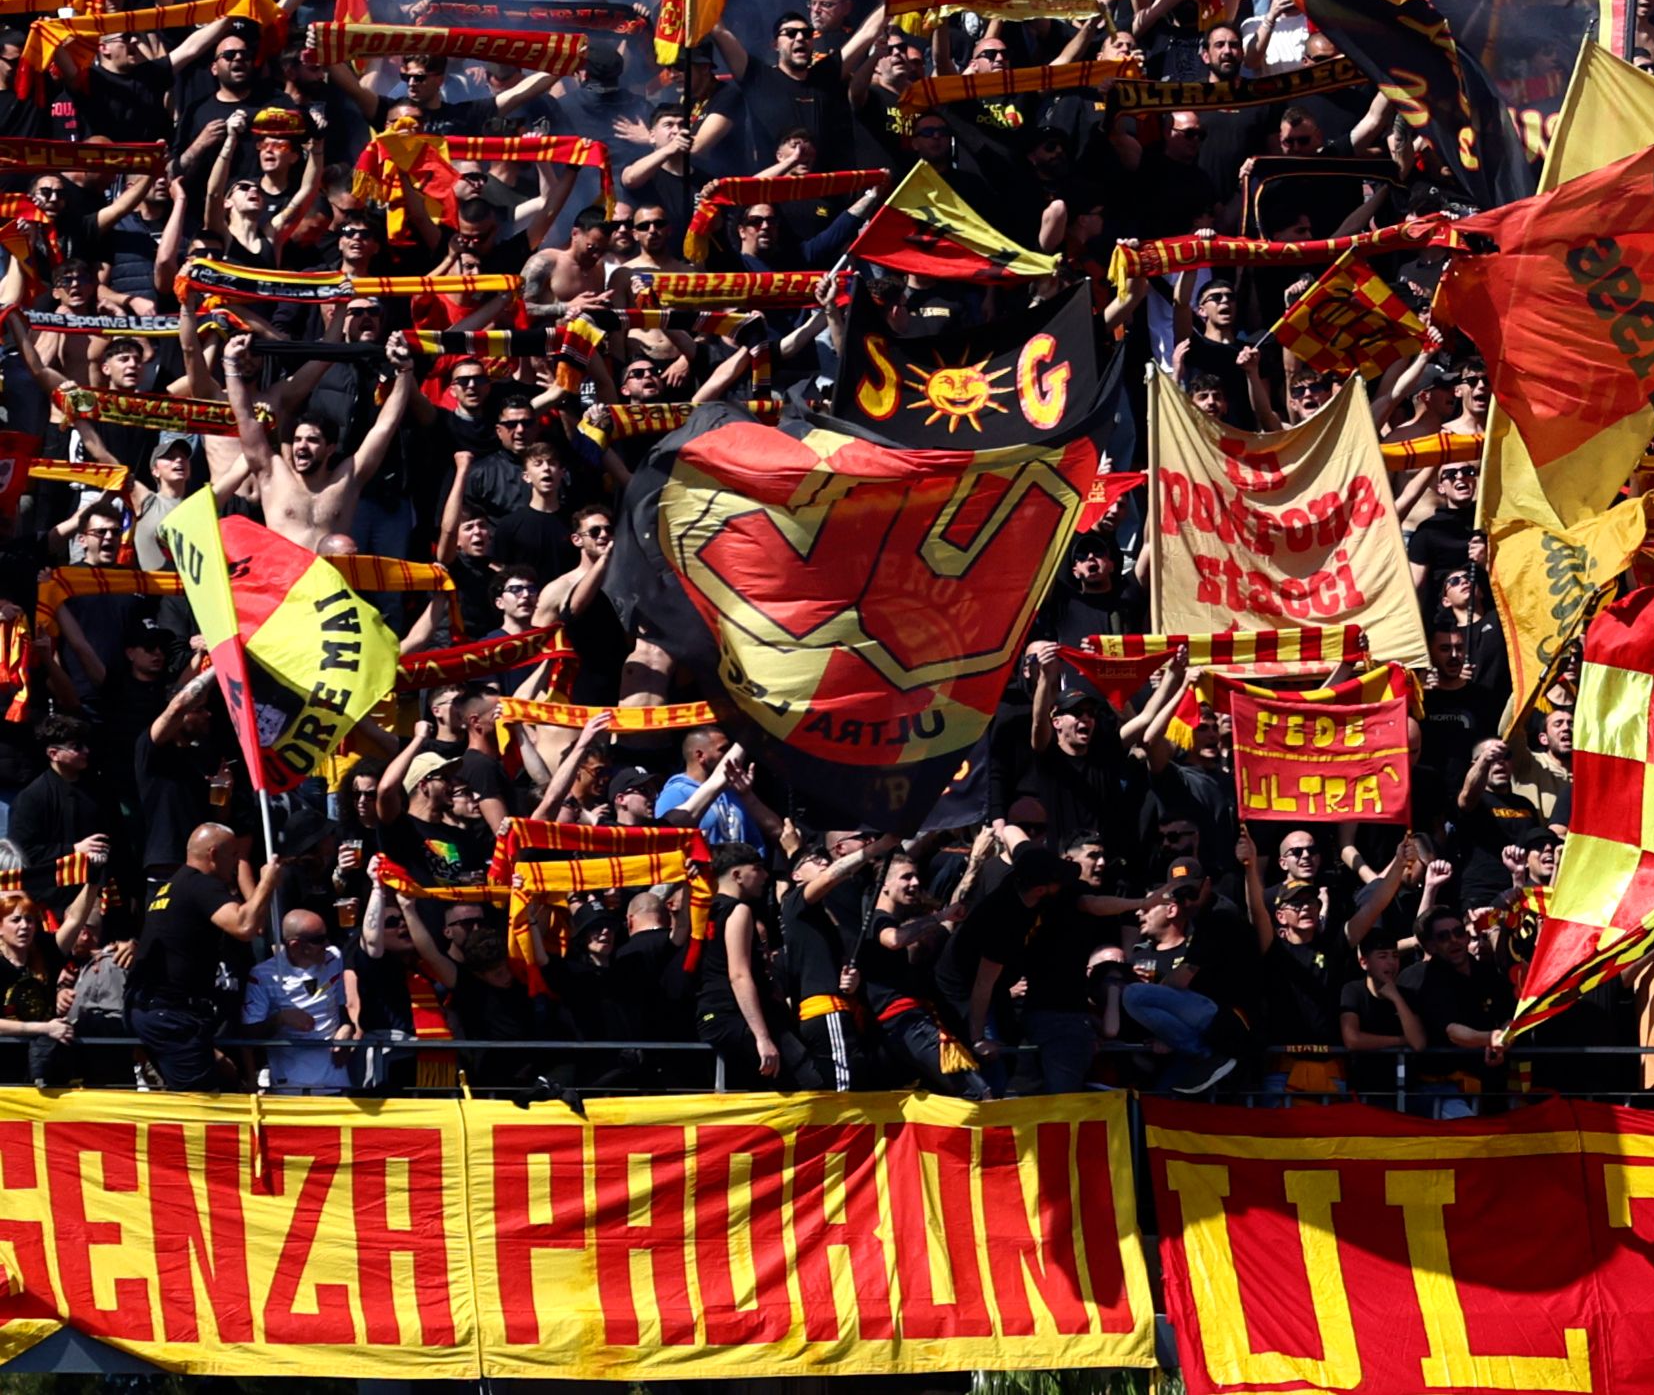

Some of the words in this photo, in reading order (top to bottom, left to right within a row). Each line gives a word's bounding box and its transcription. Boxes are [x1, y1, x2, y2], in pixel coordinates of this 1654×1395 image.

[348, 30, 447, 58] FORZA
[451, 35, 546, 62] LECCE
[66, 313, 129, 330] Sportiva
[856, 332, 900, 421] S
[1015, 331, 1074, 430] G
[1225, 437, 1287, 492] in
[1199, 547, 1364, 617] stacci
[313, 587, 363, 681] MAI
[1253, 709, 1366, 750] FEDE
[0, 1120, 456, 1347] SENZA
[492, 1120, 1135, 1347] PADRONI
